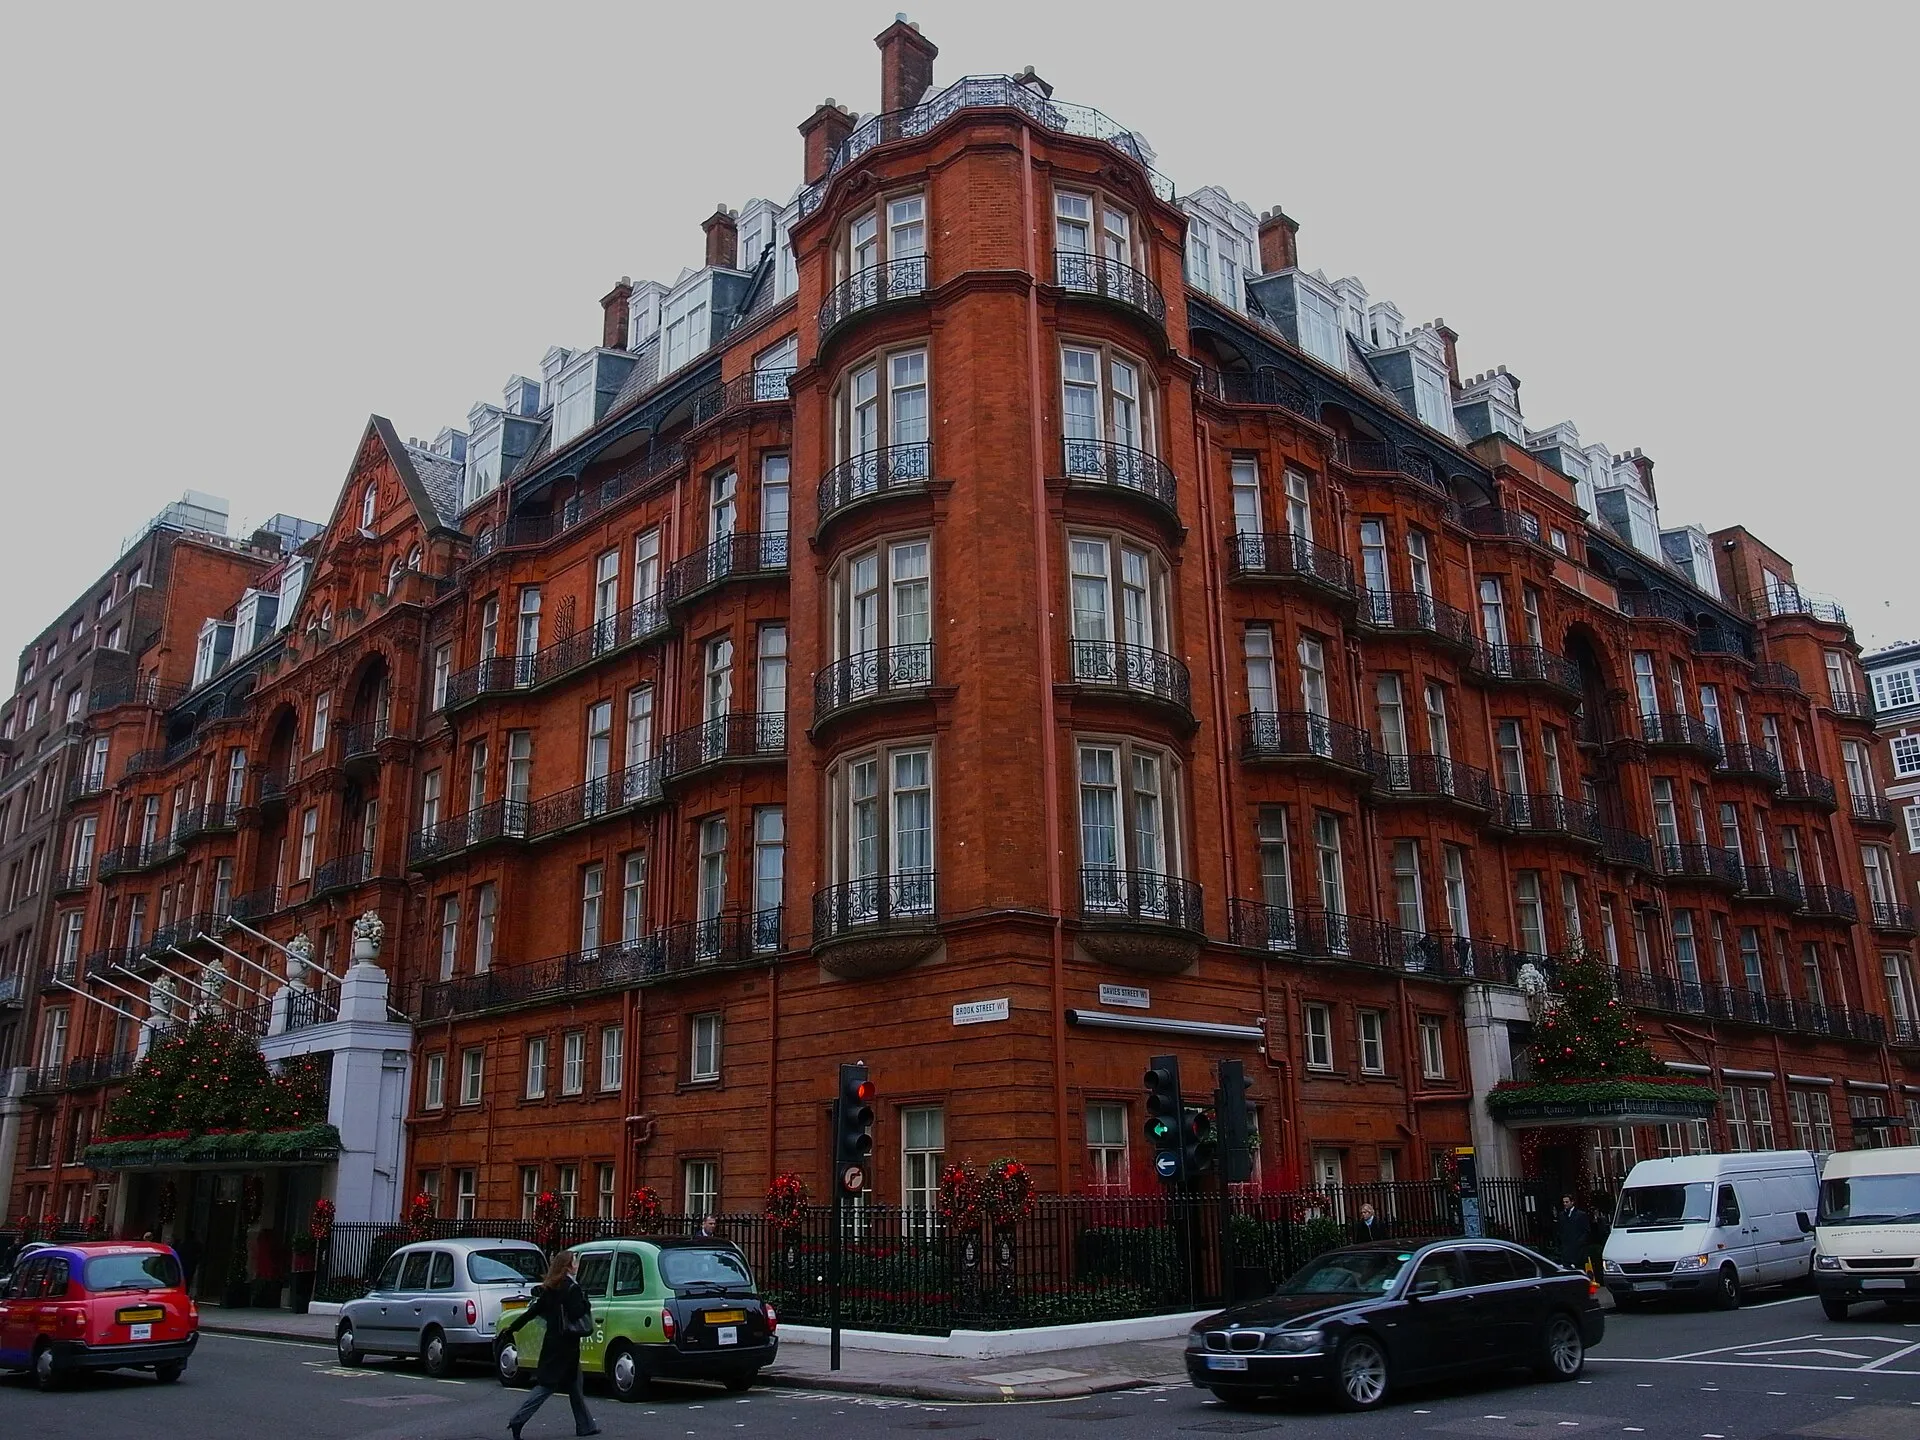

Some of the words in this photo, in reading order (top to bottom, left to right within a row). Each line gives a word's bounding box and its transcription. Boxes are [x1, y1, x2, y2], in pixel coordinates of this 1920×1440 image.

[1102, 986, 1121, 996] DAVIES
[1121, 988, 1139, 998] STREET
[955, 1005, 975, 1016] BROOK
[975, 1002, 996, 1013] STREET
[996, 1001, 1005, 1010] W1
[1543, 1104, 1576, 1116] Ramsay
